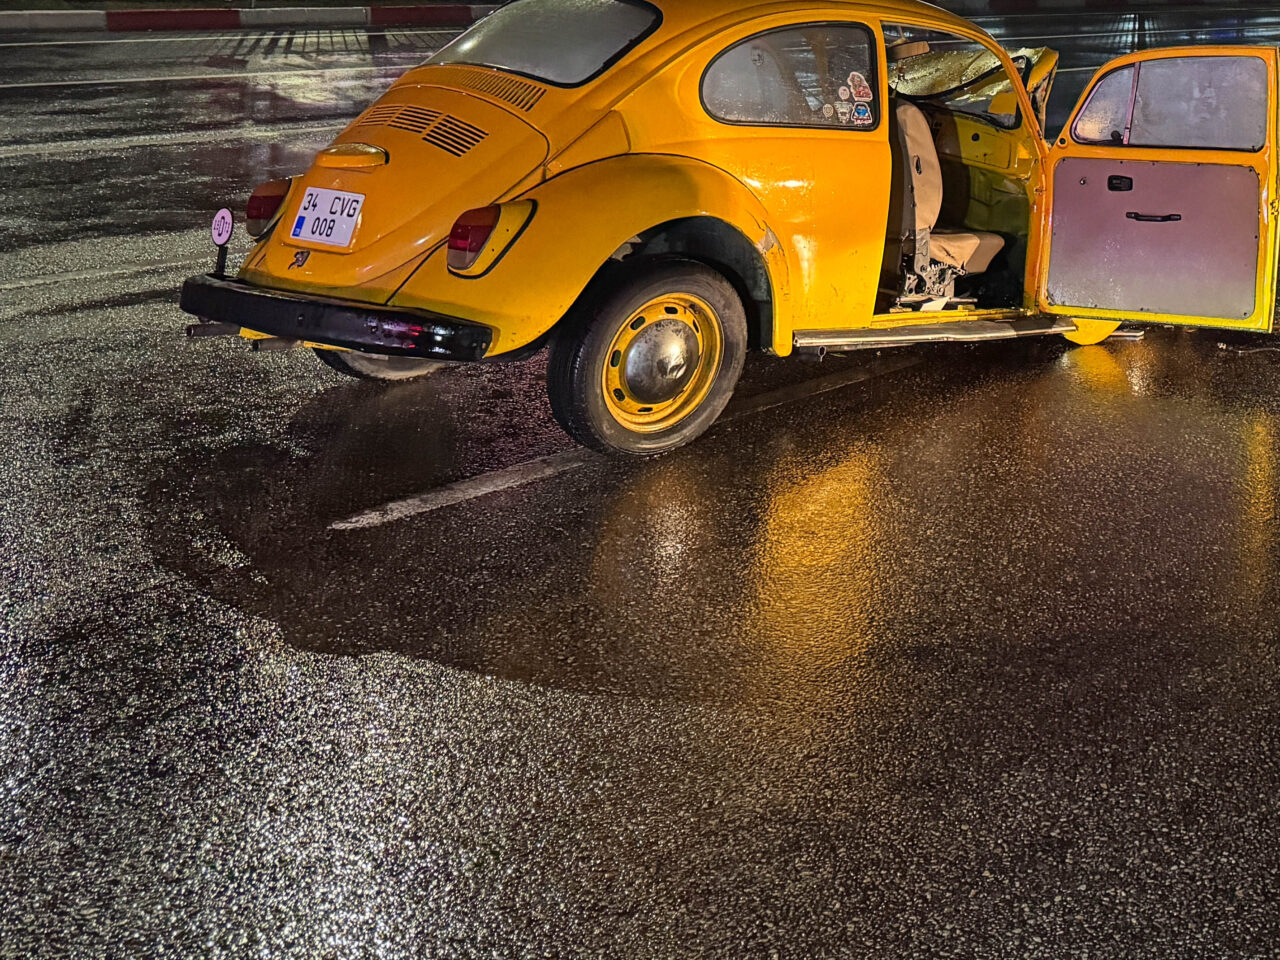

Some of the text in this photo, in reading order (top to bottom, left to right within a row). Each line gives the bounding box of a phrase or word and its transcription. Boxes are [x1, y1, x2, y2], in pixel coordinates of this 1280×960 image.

[303, 192, 360, 218] 34 CVG
[311, 216, 337, 238] 008
